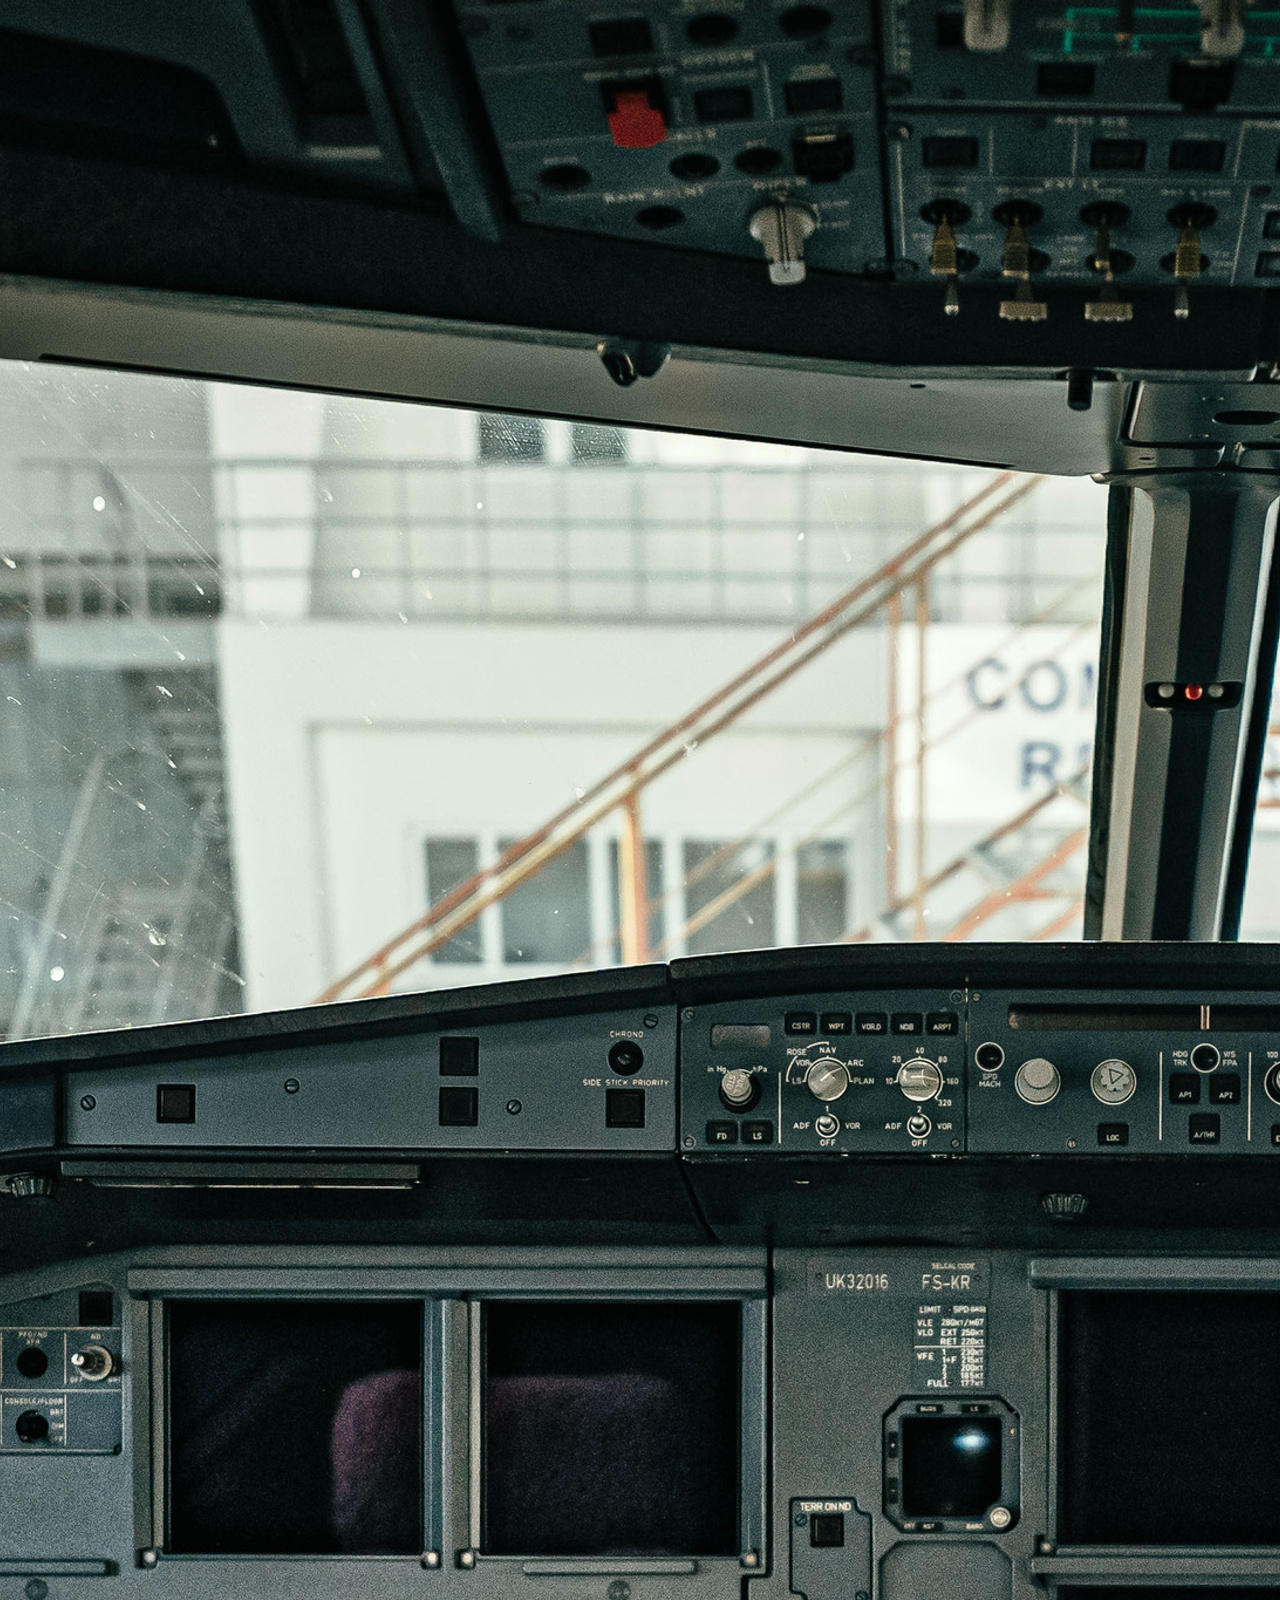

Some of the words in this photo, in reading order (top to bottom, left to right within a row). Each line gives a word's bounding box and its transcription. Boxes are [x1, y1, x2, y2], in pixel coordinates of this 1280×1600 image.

[610, 1030, 643, 1038] CHRONO
[825, 1273, 888, 1289] UK32016
[922, 1274, 970, 1290] FS-KR
[800, 1502, 823, 1511] TERR
[825, 1502, 837, 1511] ON
[840, 1503, 851, 1511] ND
